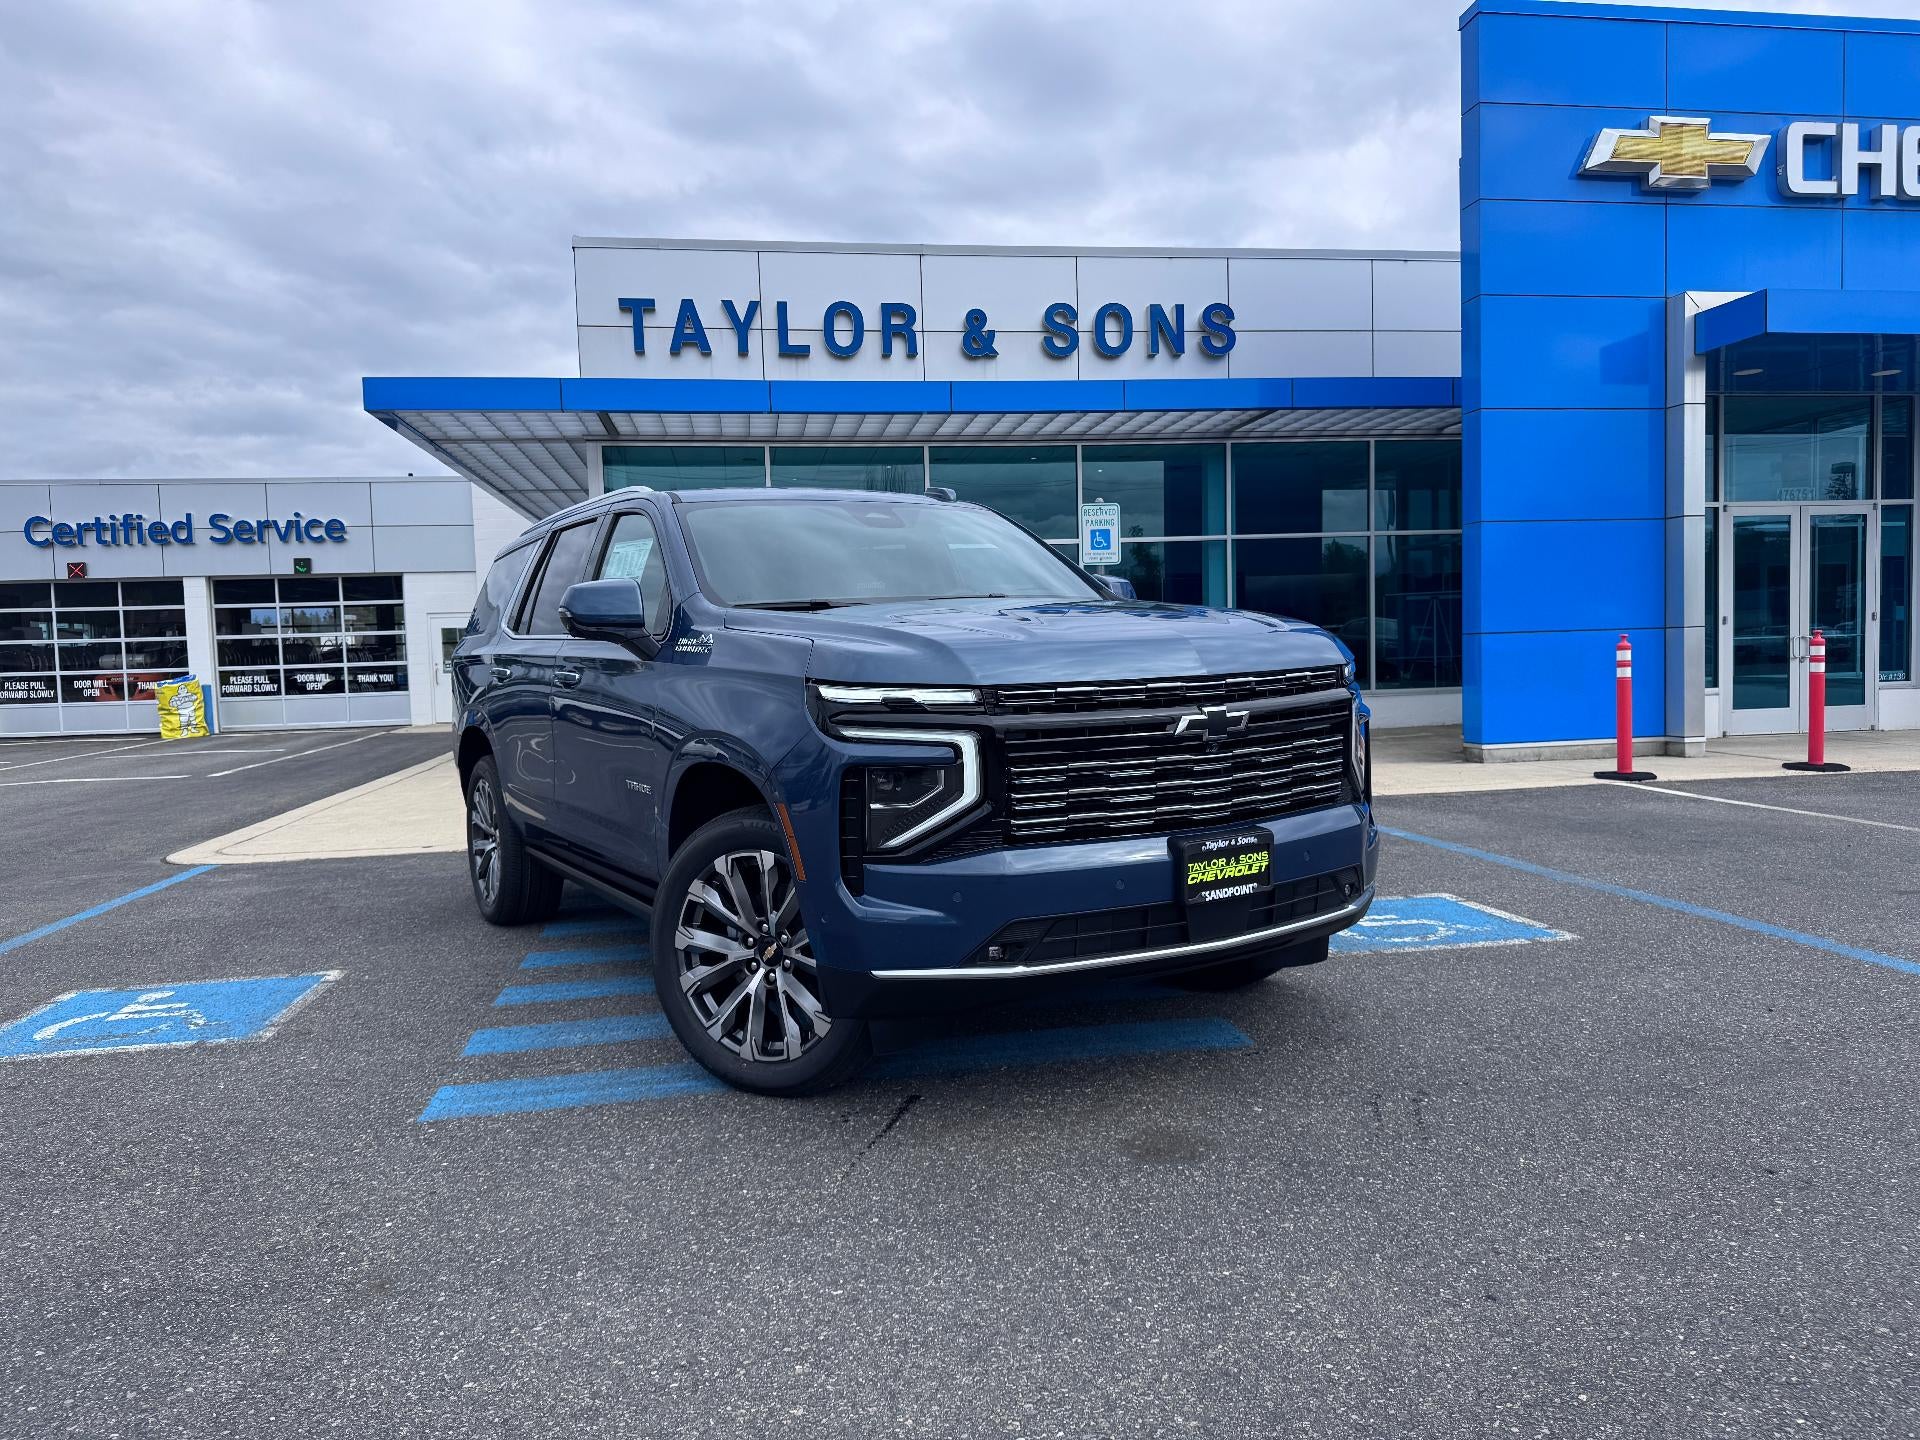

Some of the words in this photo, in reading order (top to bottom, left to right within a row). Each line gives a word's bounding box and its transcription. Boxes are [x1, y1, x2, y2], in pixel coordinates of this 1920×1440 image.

[618, 297, 918, 358] TAYLOR
[961, 308, 1000, 357] &
[1042, 302, 1237, 358] SONS
[1083, 507, 1117, 517] RESERVED
[1085, 518, 1115, 527] PARKING
[23, 512, 195, 548] Certified
[208, 511, 348, 546] Service
[229, 675, 253, 685] PLEASE
[254, 674, 270, 684] PULL
[297, 673, 314, 683] DOOR
[315, 673, 329, 682] WILL
[357, 673, 378, 683] THANK
[379, 673, 394, 682] YOU!
[4, 681, 29, 690] PLEASE
[30, 680, 46, 690] PULL
[73, 680, 92, 689] DOOR
[92, 679, 109, 688] WILL
[137, 681, 157, 690] THAN
[221, 684, 252, 693] FORWARD
[253, 683, 278, 693] SLOWLY
[306, 682, 323, 691] OPEN
[0, 689, 28, 699] ORWARD
[29, 689, 55, 699] SLOWLY
[83, 688, 100, 697] OPEN
[1205, 839, 1230, 851] Taylor
[1237, 836, 1254, 846] Sons
[1187, 857, 1227, 873] TAYLOR
[1229, 856, 1237, 867] &
[1239, 850, 1269, 863] SONS
[1187, 861, 1269, 885] CHEVROLET
[1205, 883, 1254, 902] SANDPOINT
